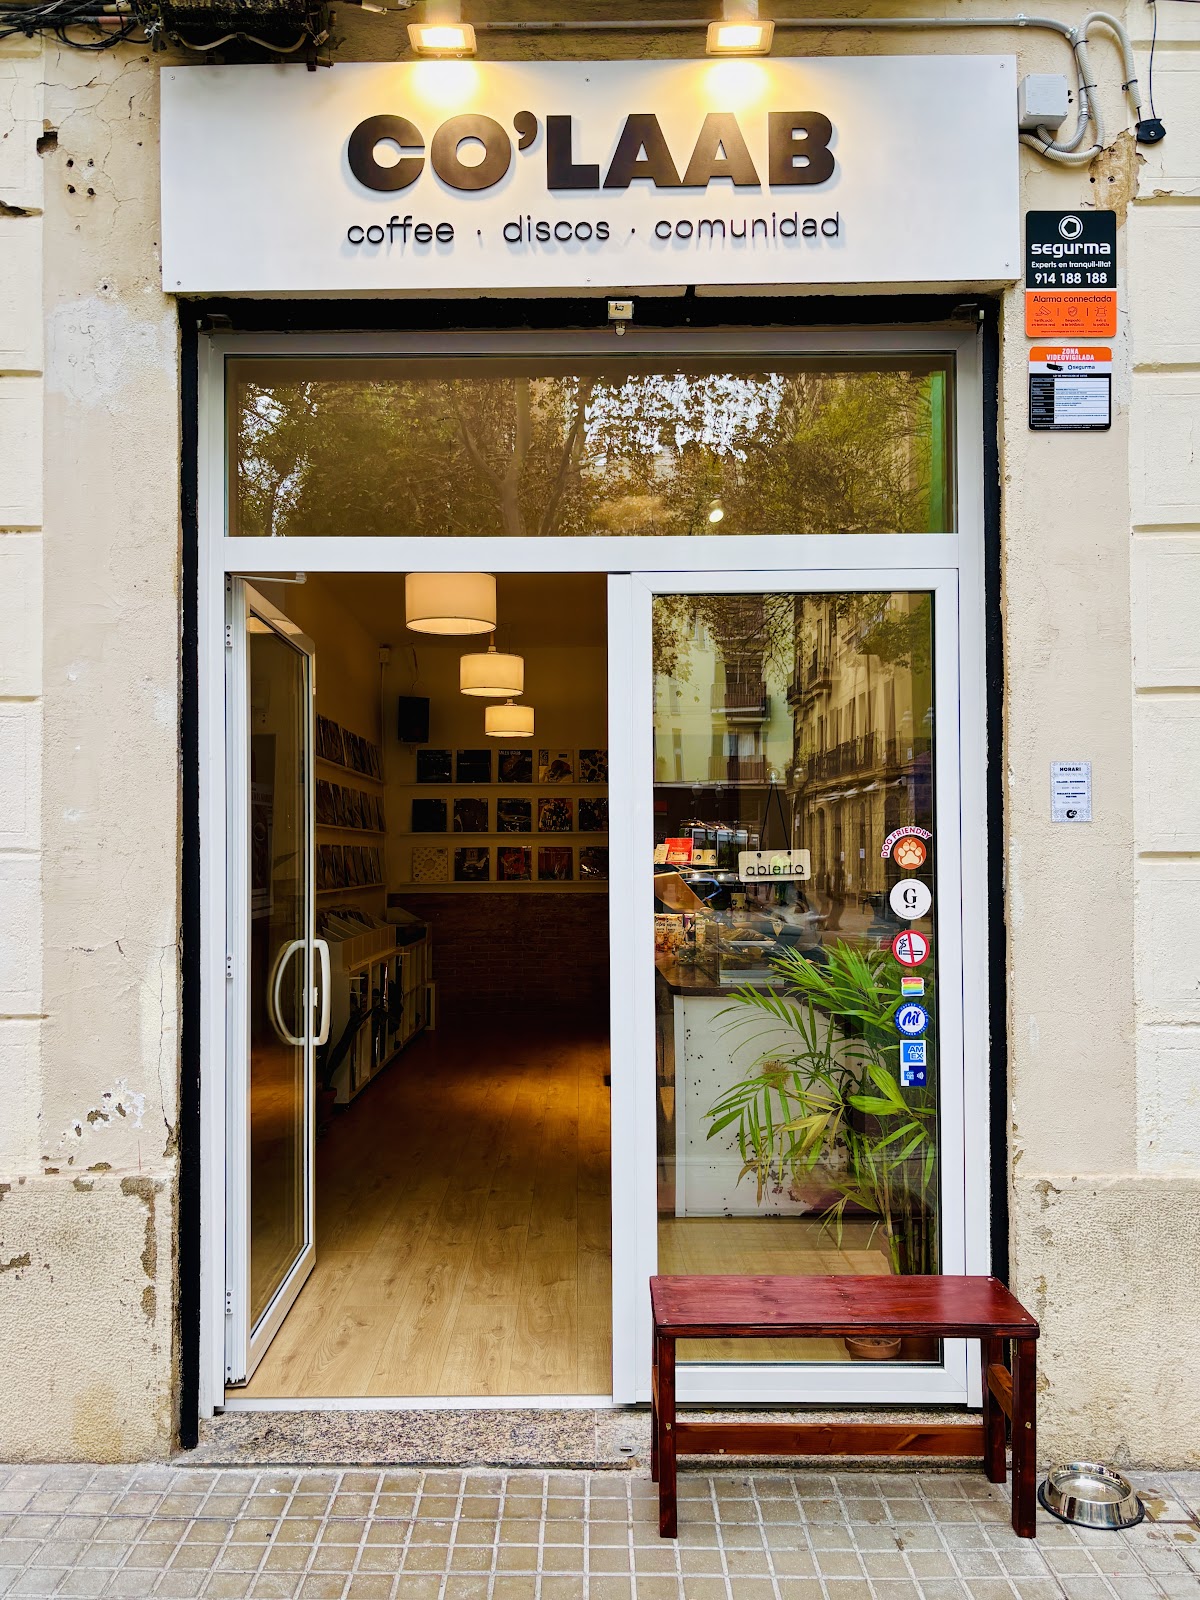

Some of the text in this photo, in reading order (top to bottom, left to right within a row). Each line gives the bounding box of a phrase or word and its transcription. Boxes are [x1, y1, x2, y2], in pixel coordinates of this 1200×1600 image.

[347, 211, 840, 244] coffee discos comunidad
[1031, 243, 1111, 258] segurma
[1031, 261, 1057, 269] Experts
[1035, 273, 1108, 284] 914 188 188
[1033, 294, 1112, 303] Alarma connectada
[882, 827, 932, 857] DOG FRIENDLY
[746, 862, 804, 875] abierto
[903, 888, 917, 904] G
